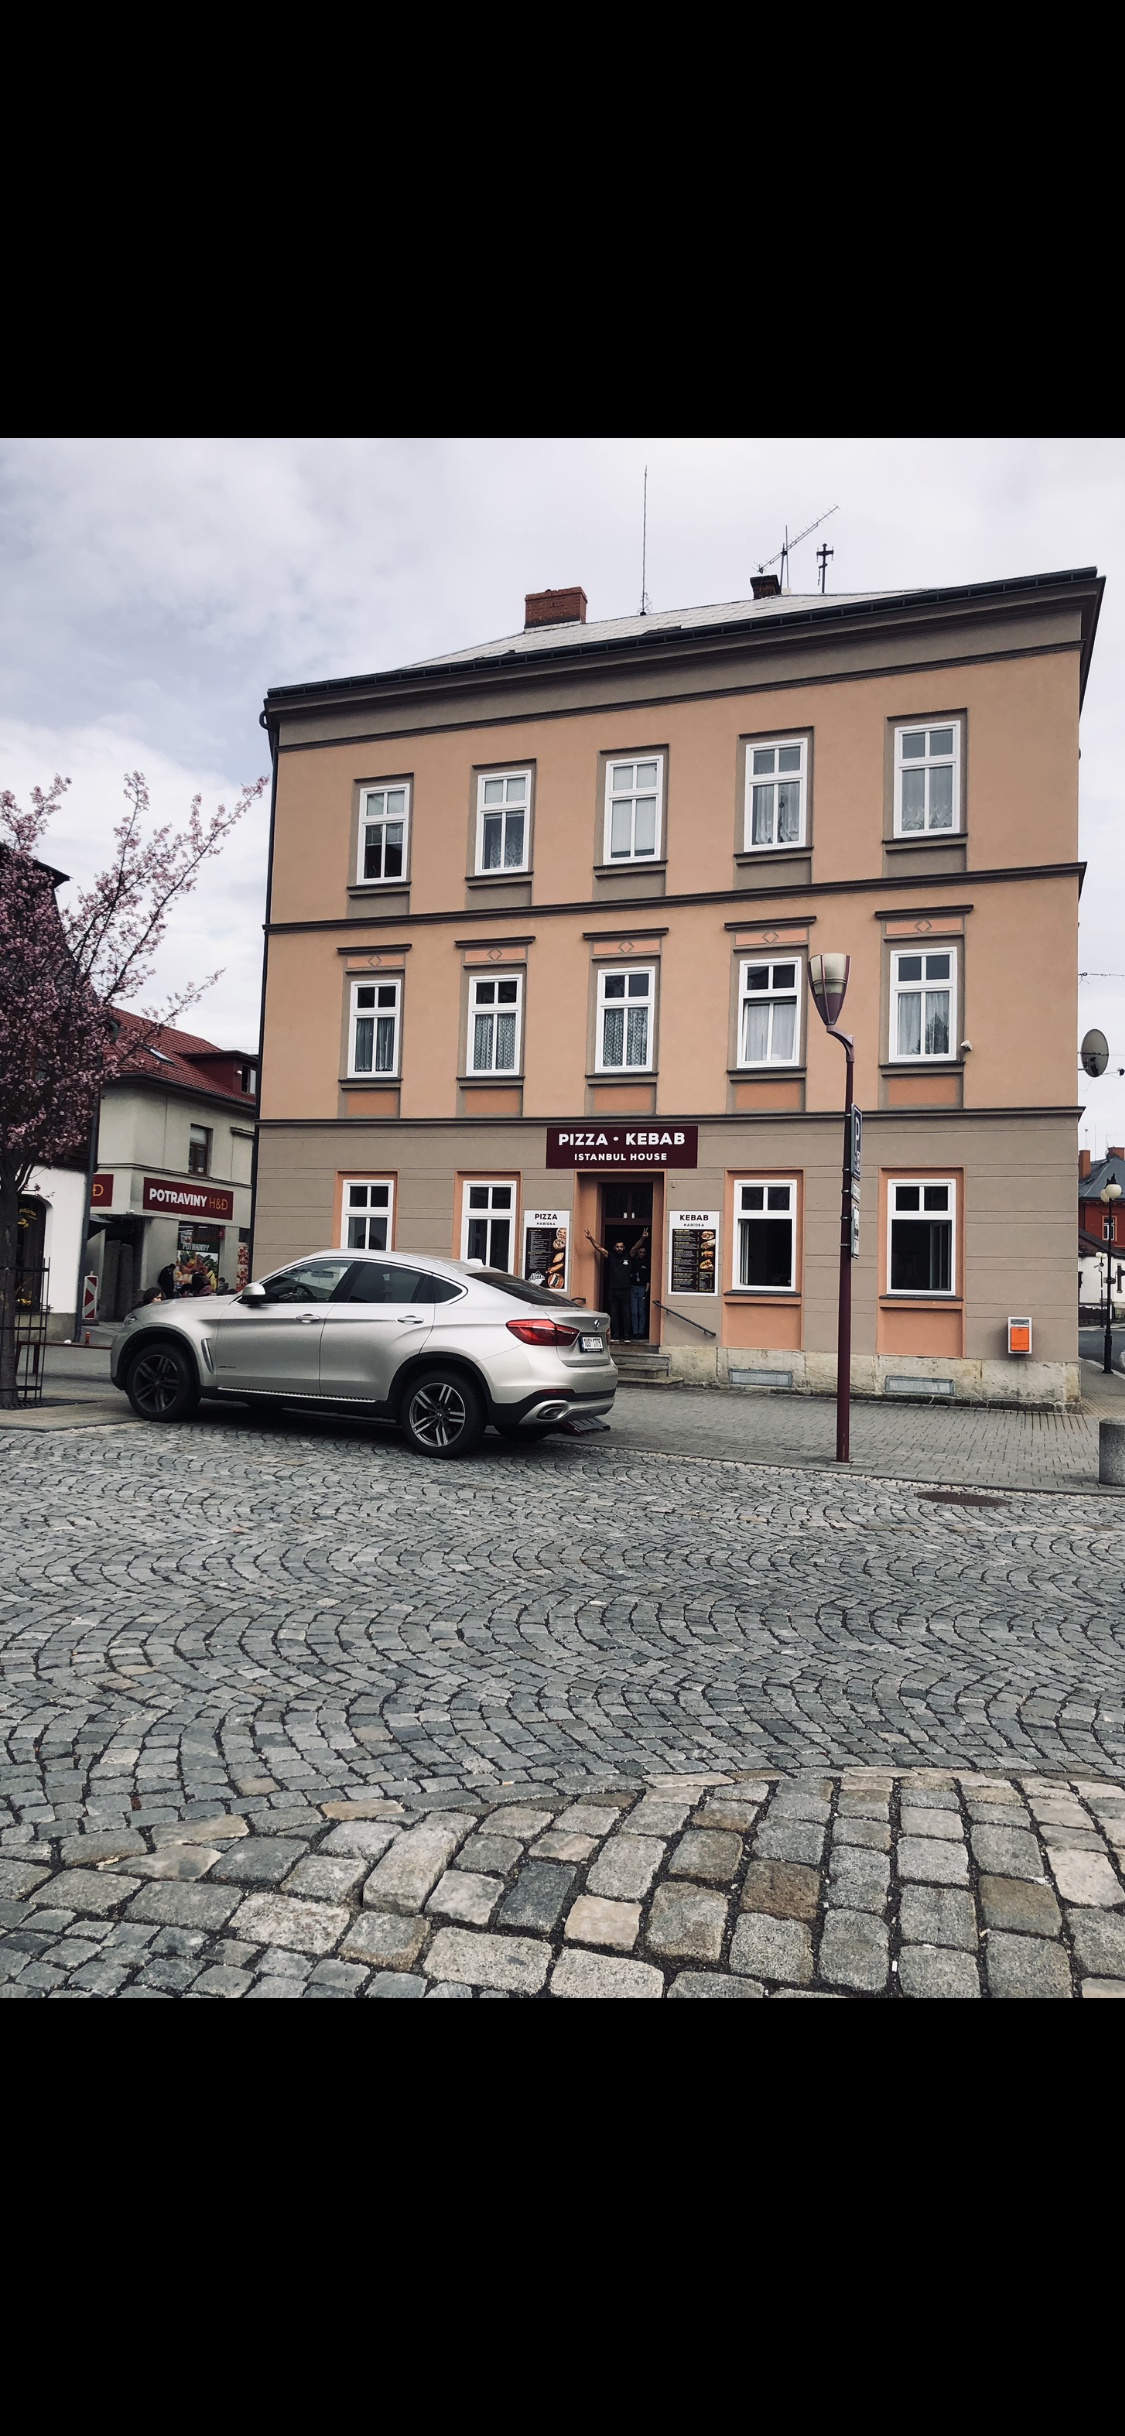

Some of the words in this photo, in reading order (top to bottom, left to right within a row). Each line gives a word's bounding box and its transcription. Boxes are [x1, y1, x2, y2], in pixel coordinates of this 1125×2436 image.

[558, 1133, 608, 1146] PIZZA
[625, 1132, 686, 1146] KEBAB
[574, 1152, 626, 1161] ISTANBUL
[629, 1152, 667, 1161] HOUSE
[149, 1187, 208, 1208] POTRAVINY
